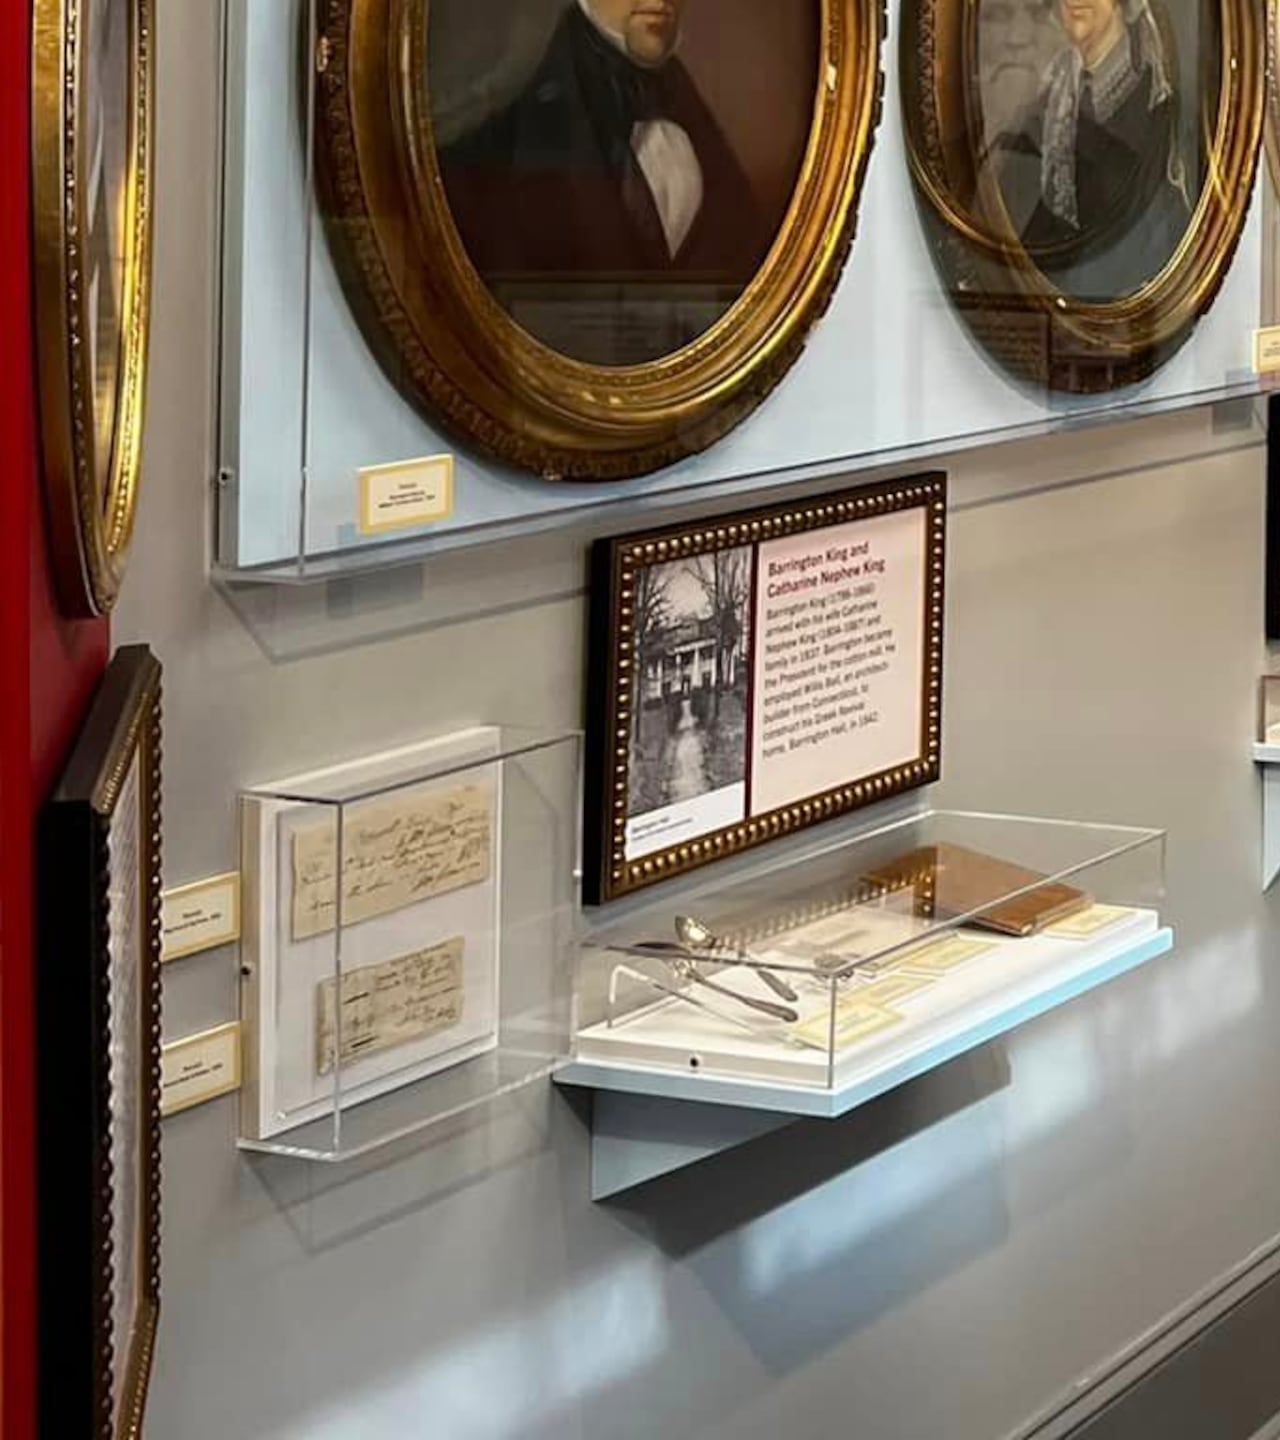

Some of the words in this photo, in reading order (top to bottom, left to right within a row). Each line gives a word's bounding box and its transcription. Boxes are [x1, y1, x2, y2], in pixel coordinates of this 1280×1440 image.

[768, 555, 823, 577] Barrington
[826, 549, 847, 561] King
[850, 542, 868, 557] and
[821, 567, 859, 584] Nephew
[863, 560, 884, 573] King
